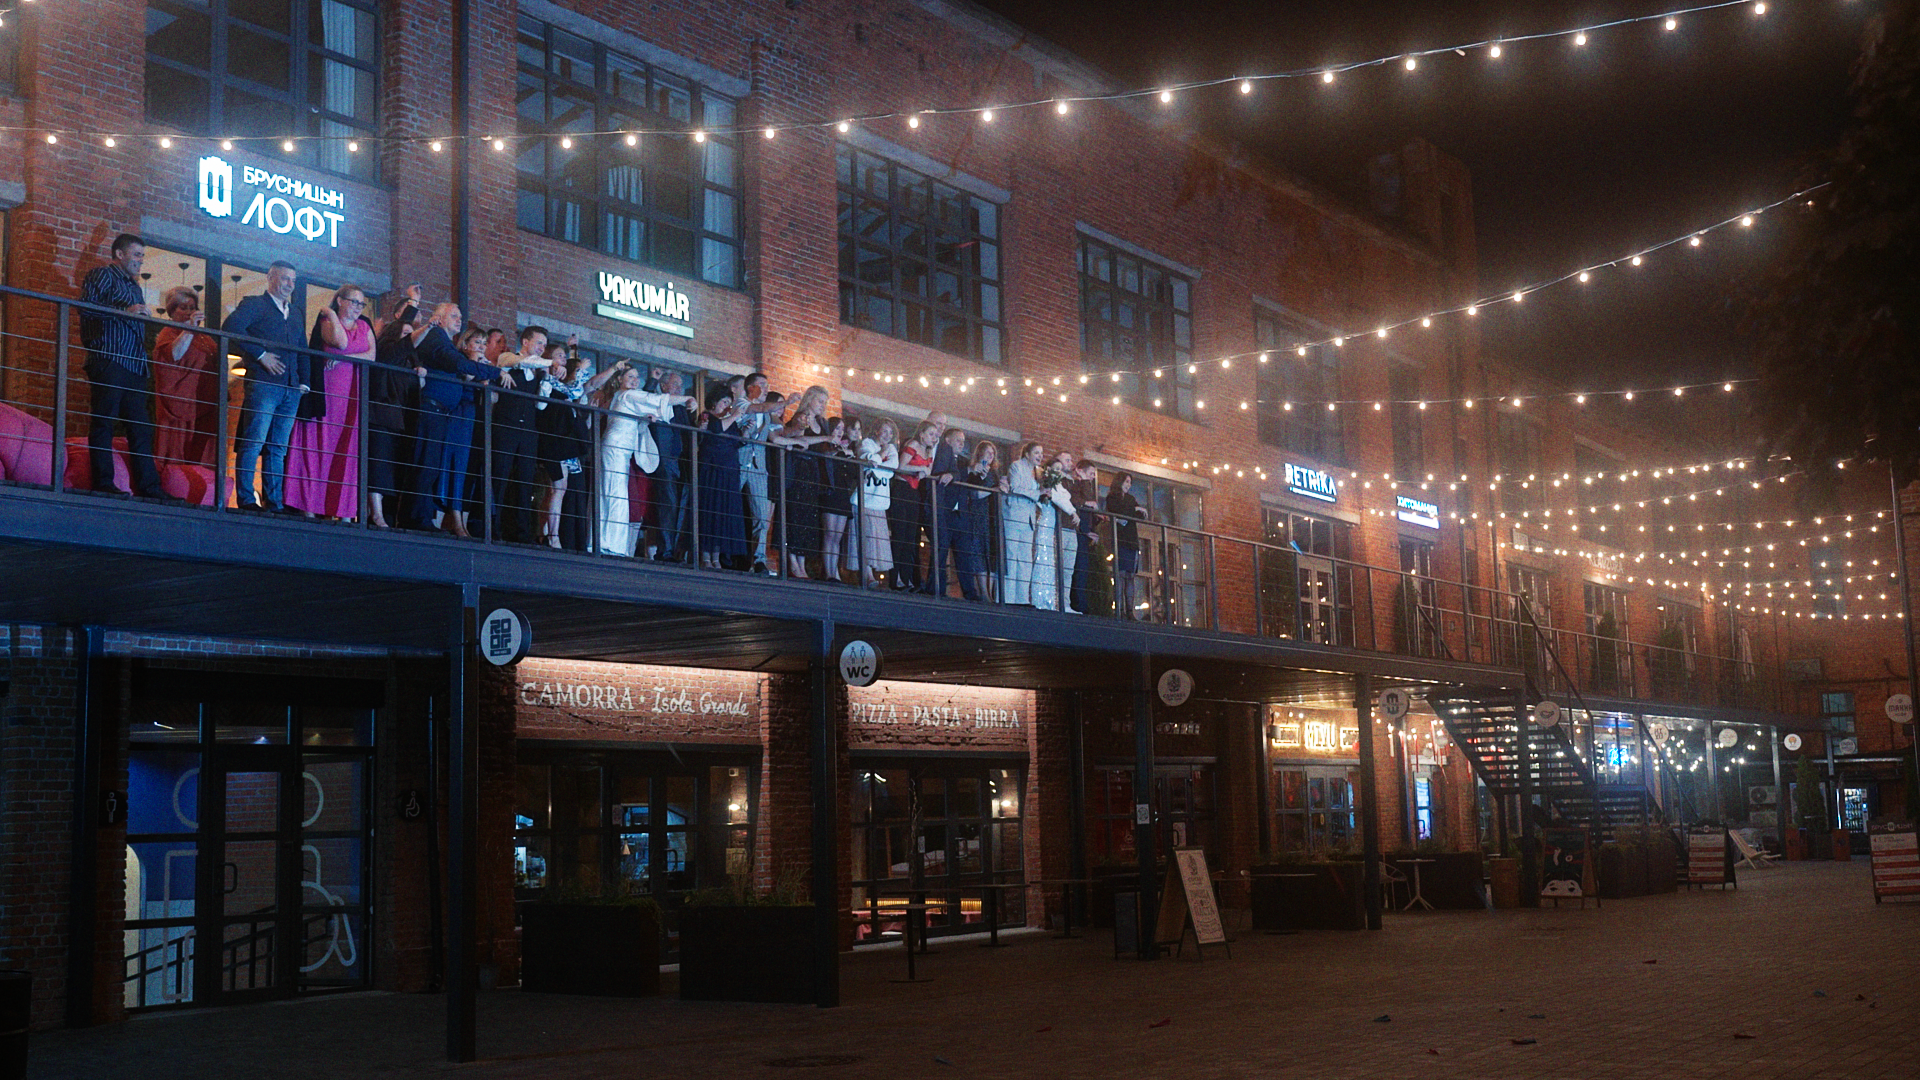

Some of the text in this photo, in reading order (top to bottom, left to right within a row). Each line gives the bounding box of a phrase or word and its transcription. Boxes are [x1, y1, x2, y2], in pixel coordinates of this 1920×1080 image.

[243, 165, 344, 210] БРУСНИЦЫН
[241, 192, 345, 248] ЛОФТ
[846, 665, 870, 679] WC
[520, 681, 750, 716] CAMORRA Isola Grande
[851, 702, 1021, 729] PIZZA PASTA BIRRA
